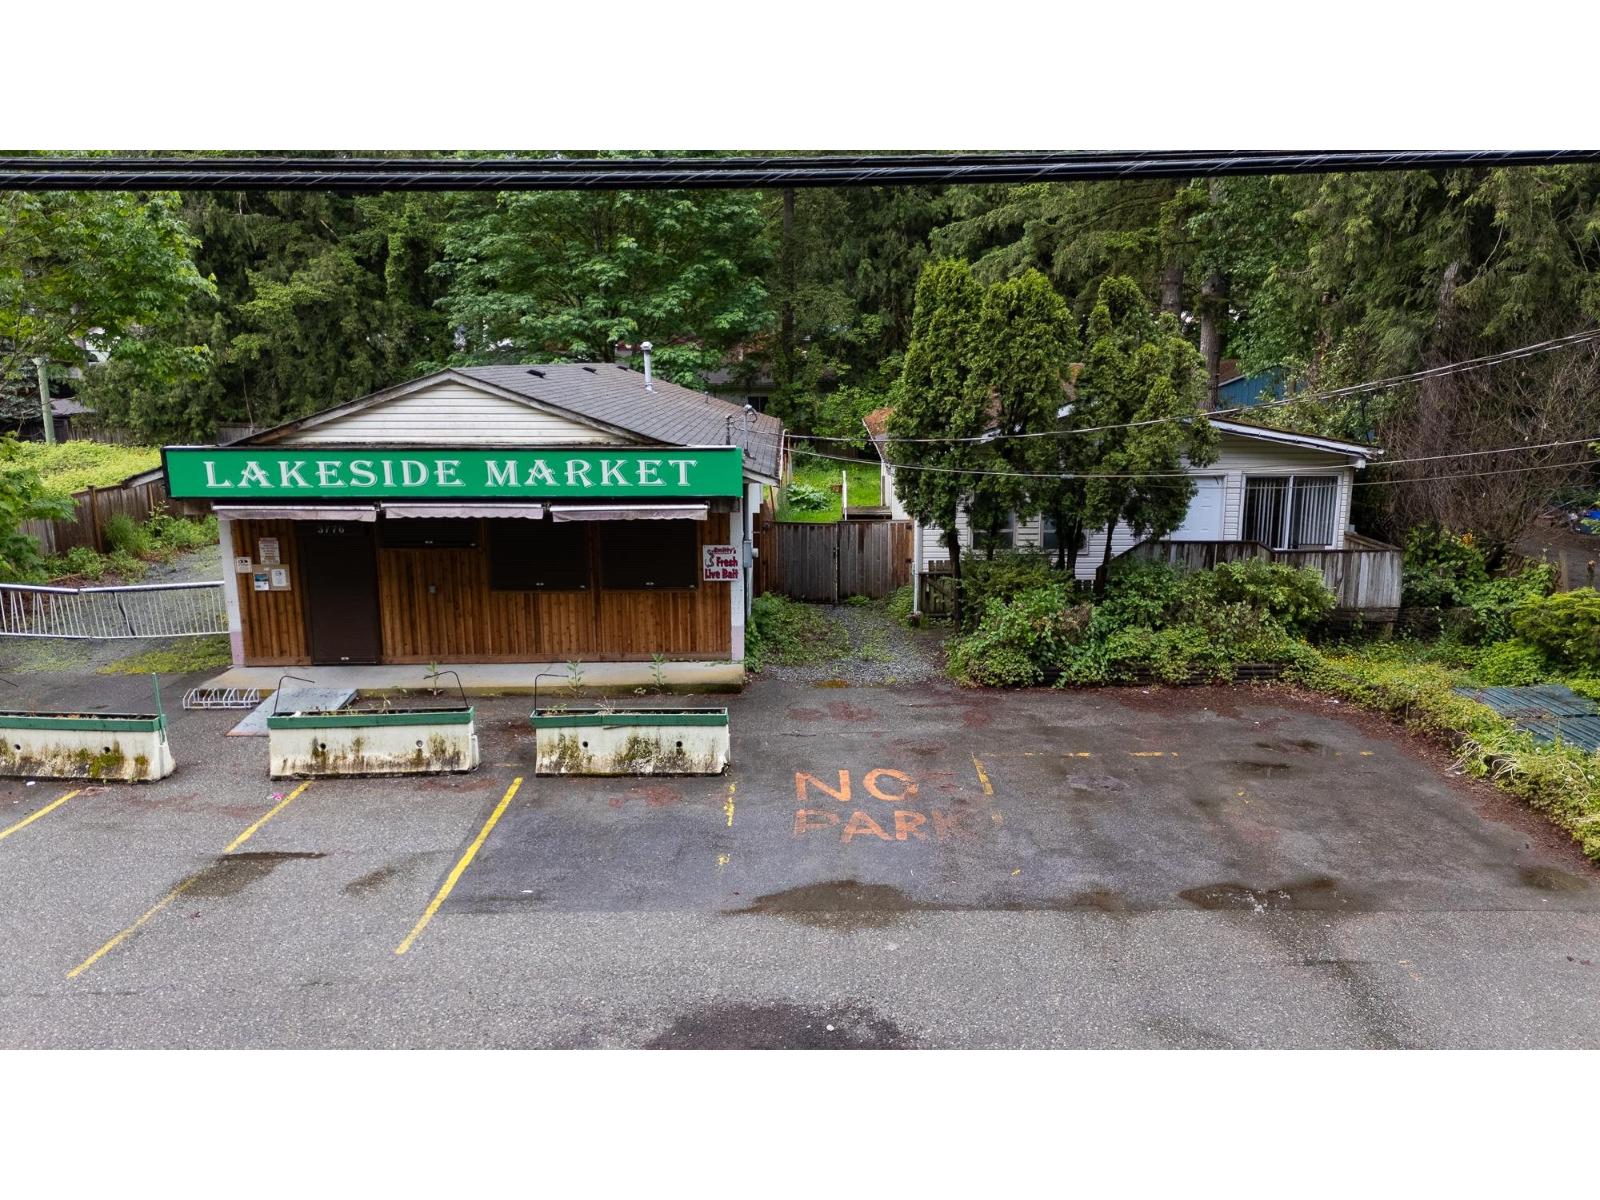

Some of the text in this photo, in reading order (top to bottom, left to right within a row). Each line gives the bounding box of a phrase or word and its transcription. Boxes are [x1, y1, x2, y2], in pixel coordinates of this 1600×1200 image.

[203, 459, 698, 488] LAKESIDE MARKET
[716, 556, 738, 567] Fresh
[705, 568, 738, 579] Live Bait
[795, 768, 919, 801] NO
